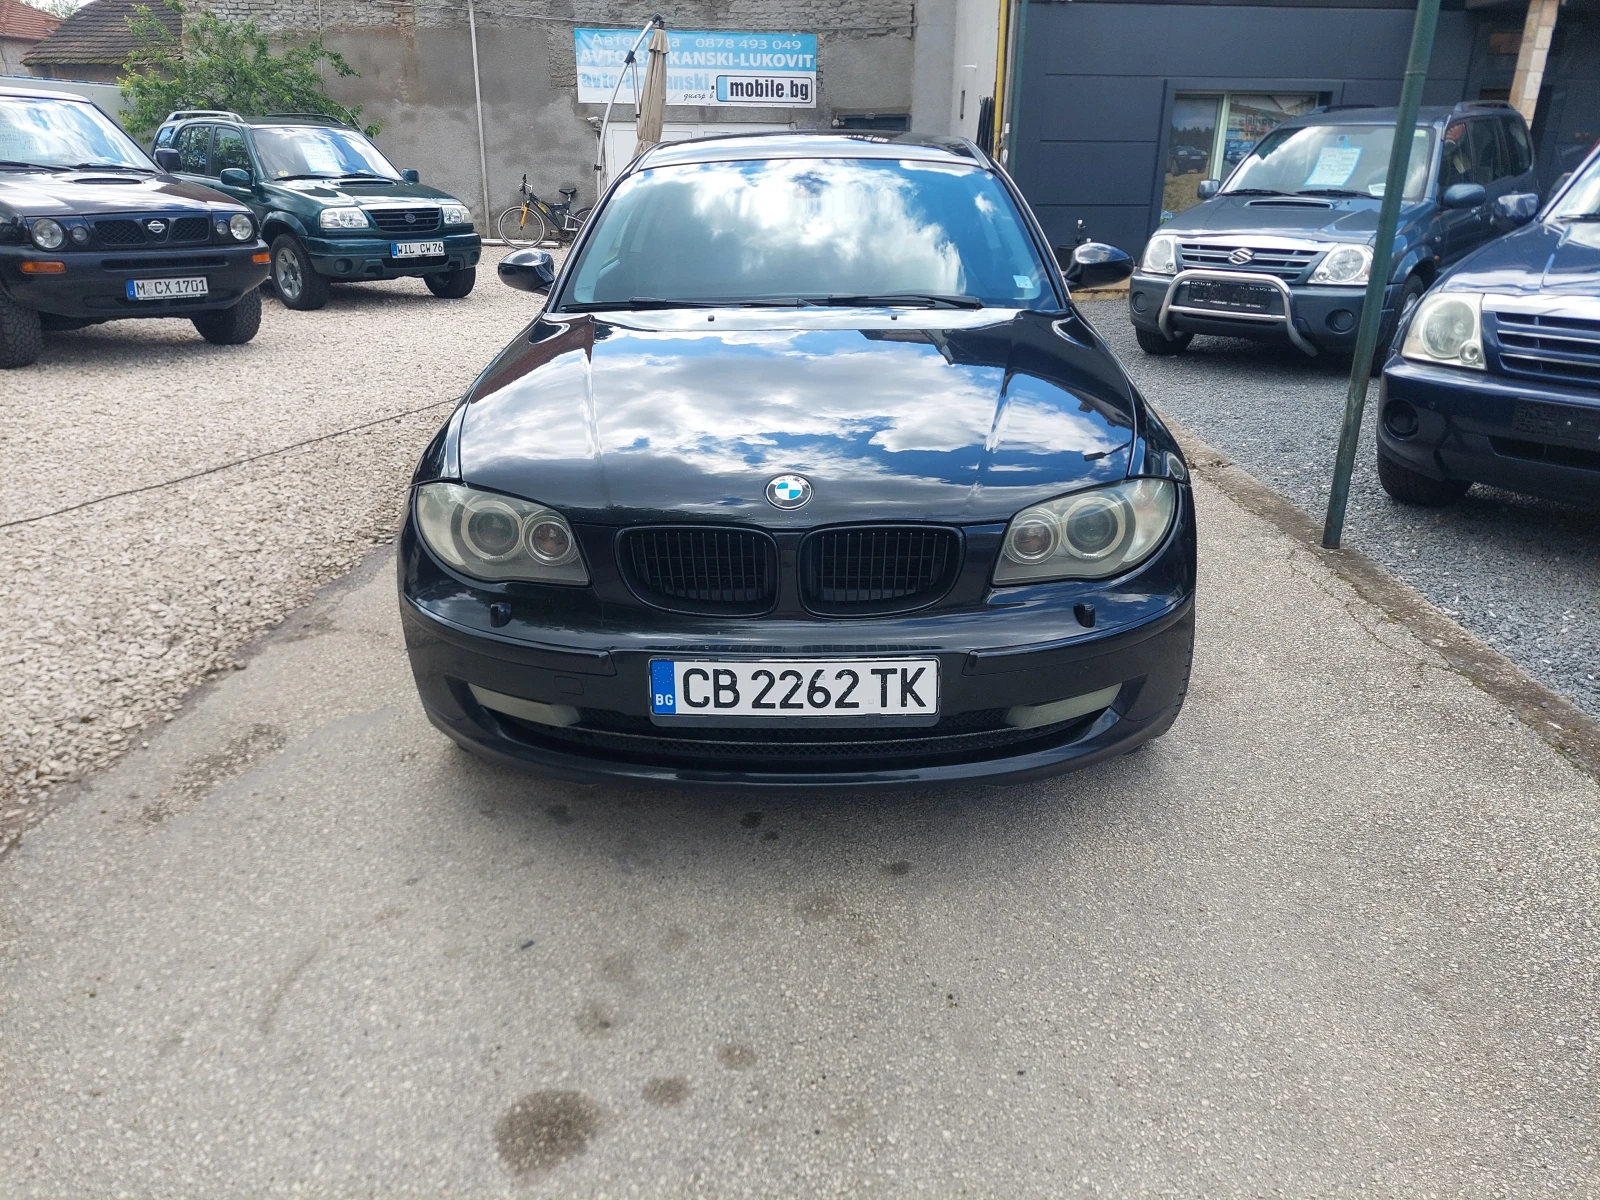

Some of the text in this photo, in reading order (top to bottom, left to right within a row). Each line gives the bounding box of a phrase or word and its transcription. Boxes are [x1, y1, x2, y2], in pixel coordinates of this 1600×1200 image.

[695, 38, 735, 49] 0878
[738, 38, 768, 49] 493
[772, 40, 802, 50] 049
[730, 79, 809, 101] mobile.bg
[397, 243, 443, 255] WIL CW 76
[135, 279, 207, 296] M CX 1701
[682, 667, 927, 710] CB 2262 TK
[655, 694, 674, 707] BG
